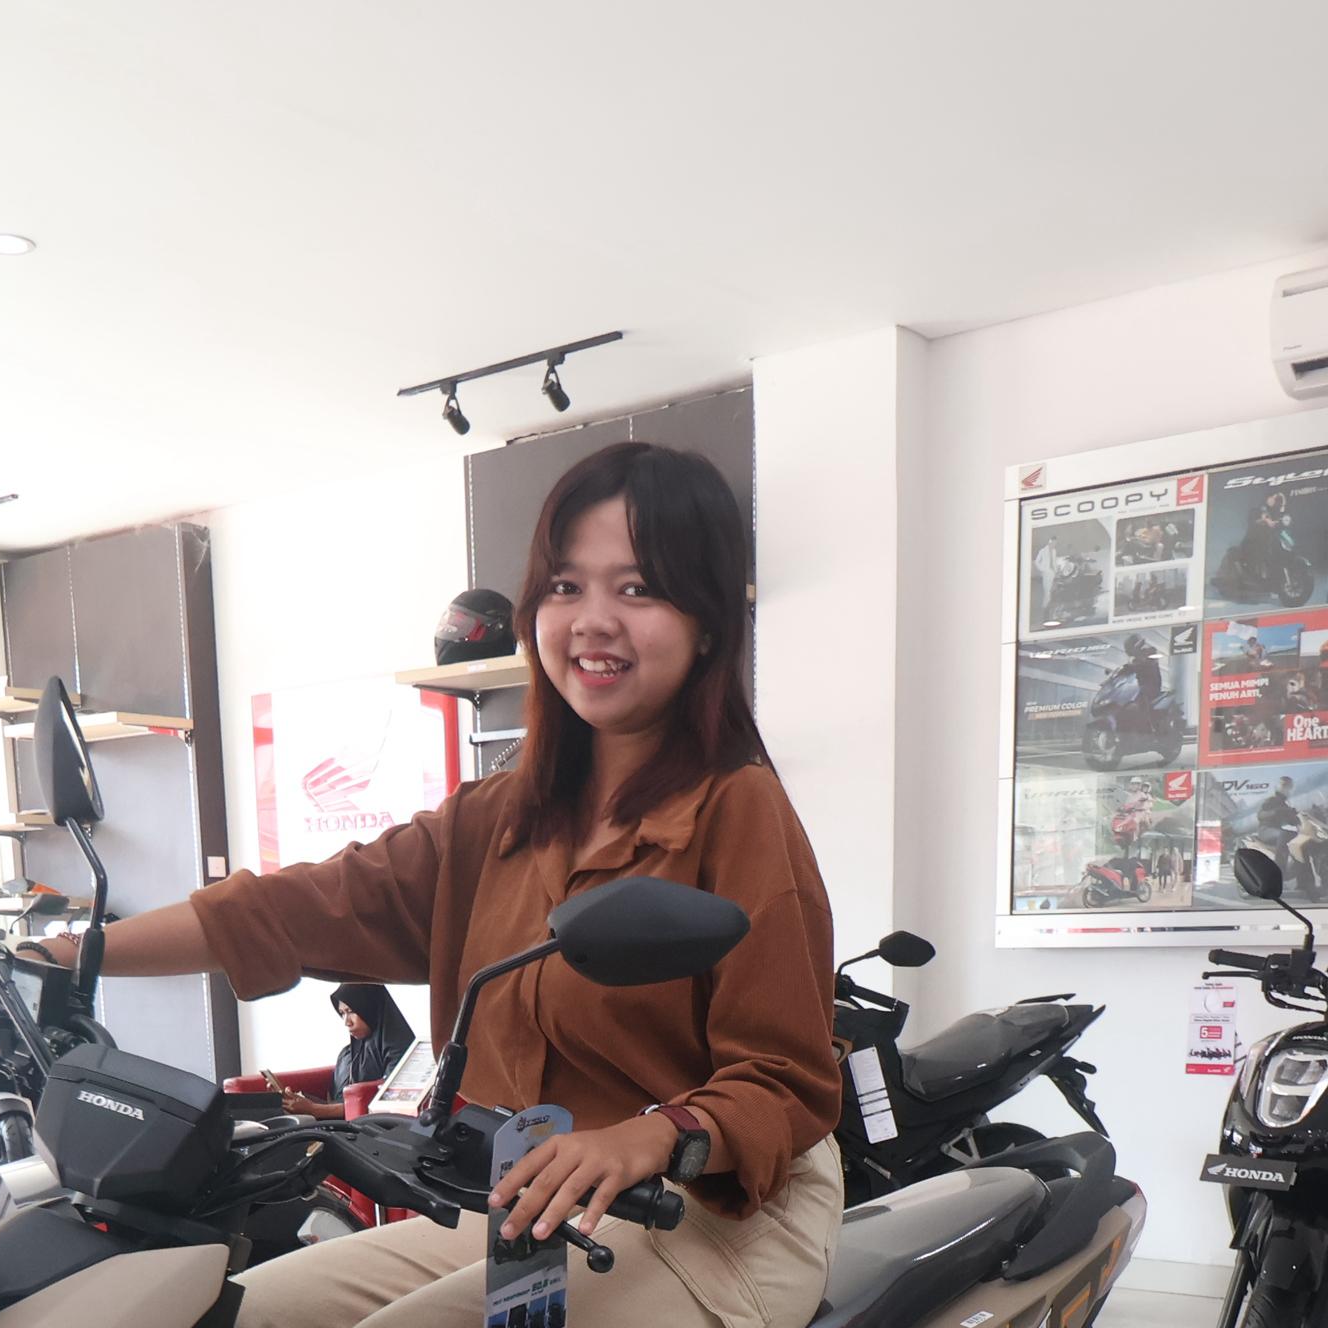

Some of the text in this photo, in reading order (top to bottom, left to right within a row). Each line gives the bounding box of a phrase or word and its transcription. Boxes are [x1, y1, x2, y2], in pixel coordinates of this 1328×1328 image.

[1031, 488, 1168, 521] SCOOPY
[1209, 677, 1269, 692] SEMUA MIMPI
[1208, 692, 1240, 702] PENUH
[1024, 700, 1088, 713] PREMIUM COLOR
[1293, 714, 1320, 728] One
[78, 1090, 145, 1121] HONDA
[1224, 1167, 1286, 1183] HONDA
